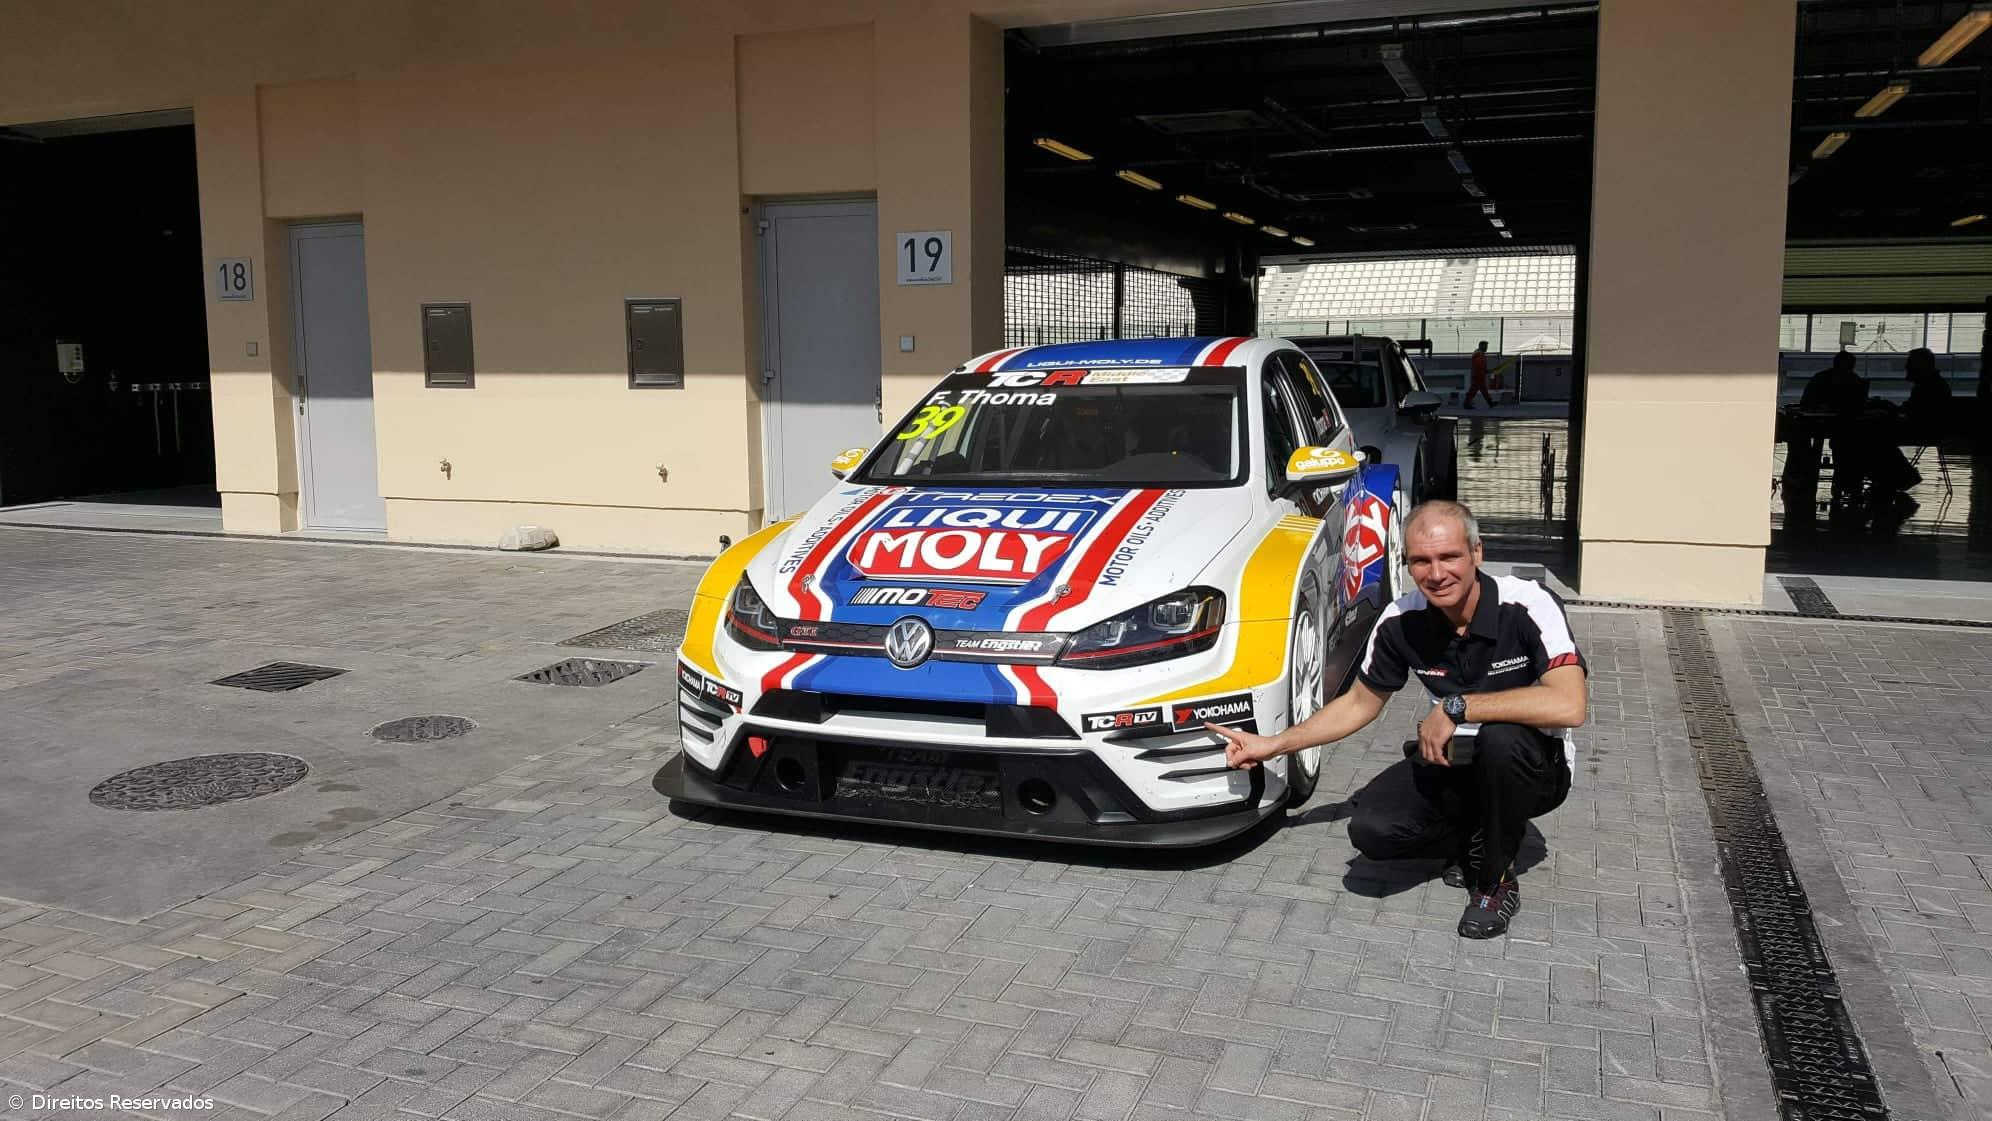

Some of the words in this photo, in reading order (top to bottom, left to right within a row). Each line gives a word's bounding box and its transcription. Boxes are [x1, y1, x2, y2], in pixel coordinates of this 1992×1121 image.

[904, 237, 943, 272] 19
[219, 263, 246, 291] 18
[986, 370, 1088, 388] TCR
[959, 390, 1057, 407] Thoma
[896, 405, 967, 440] 39
[884, 508, 1082, 531] LIQUI
[860, 530, 1069, 573] MOLY
[1098, 547, 1140, 586] MOTOR
[955, 639, 980, 648] TEAM
[1087, 712, 1135, 729] TCR
[1137, 712, 1156, 722] TV
[1192, 701, 1250, 720] YOKOHAMA
